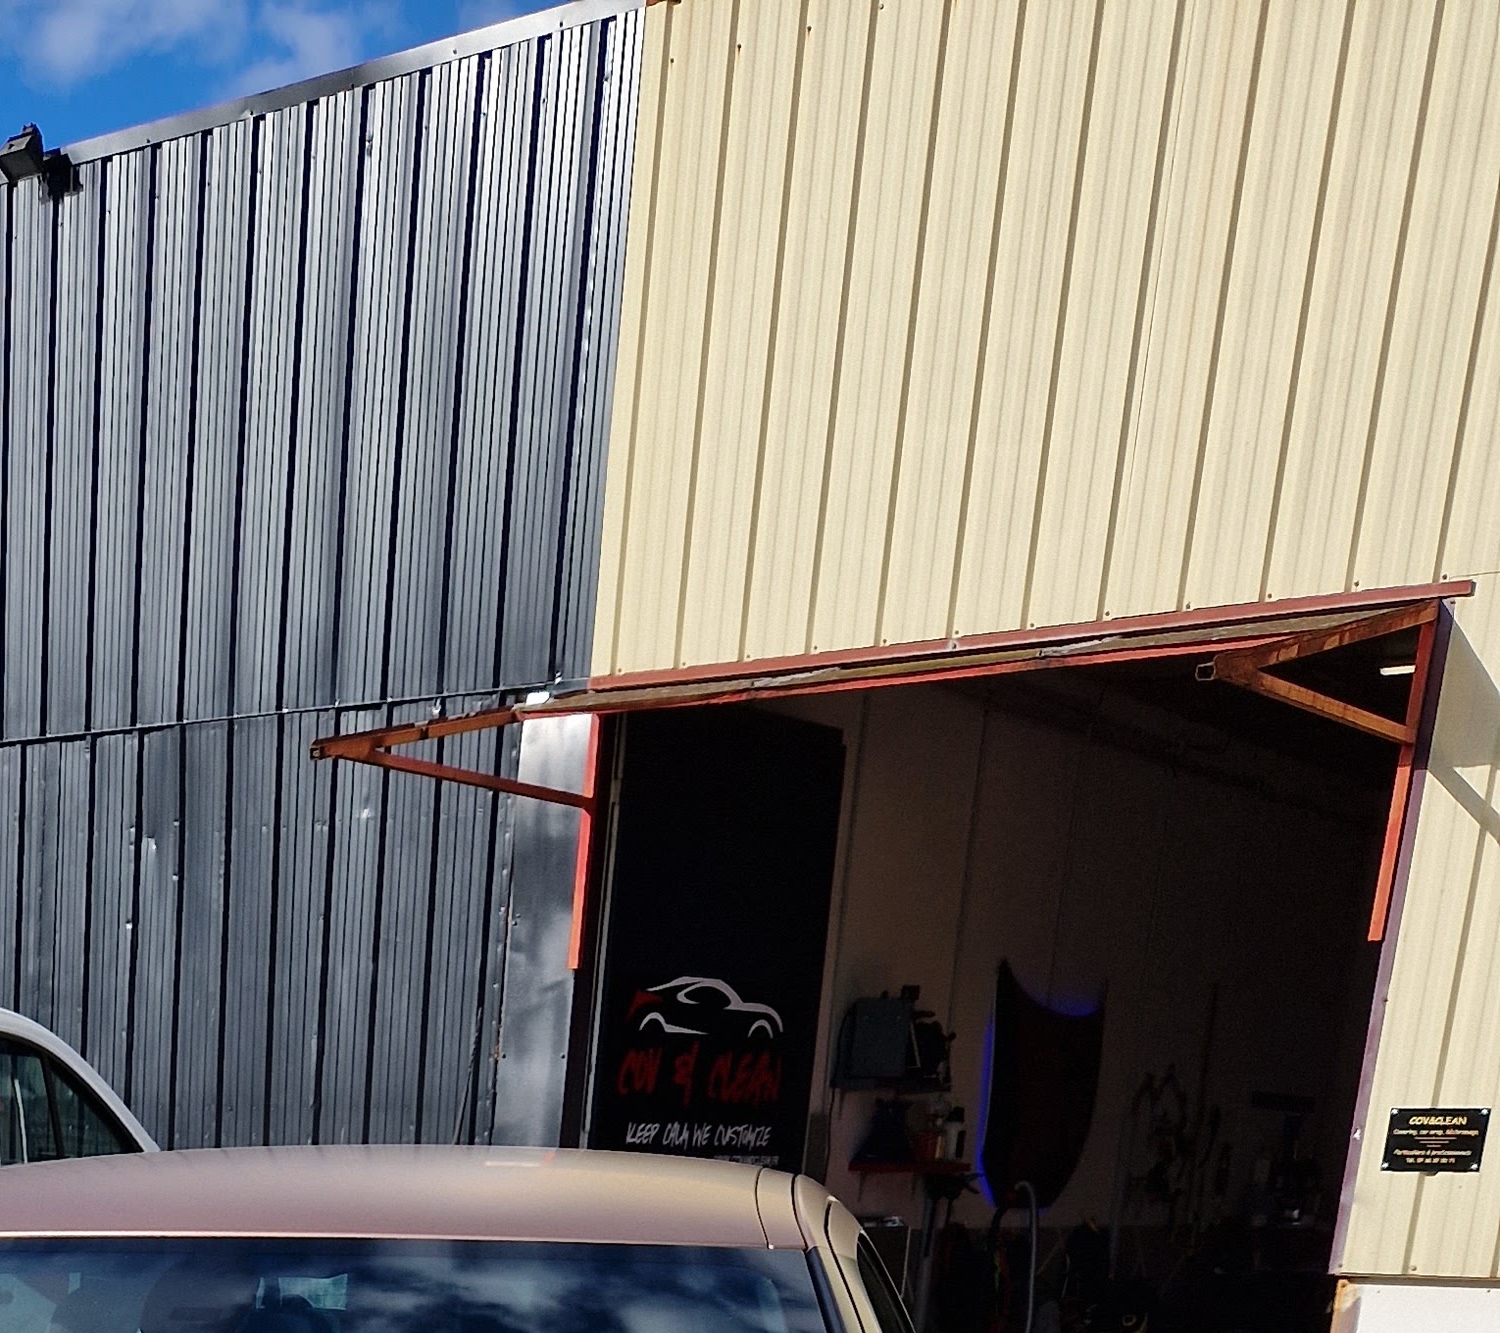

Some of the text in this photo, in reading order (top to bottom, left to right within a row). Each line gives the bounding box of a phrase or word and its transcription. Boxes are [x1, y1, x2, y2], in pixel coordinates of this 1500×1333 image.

[626, 1121, 772, 1150] KEEP CALM WE CUSTOMIZE
